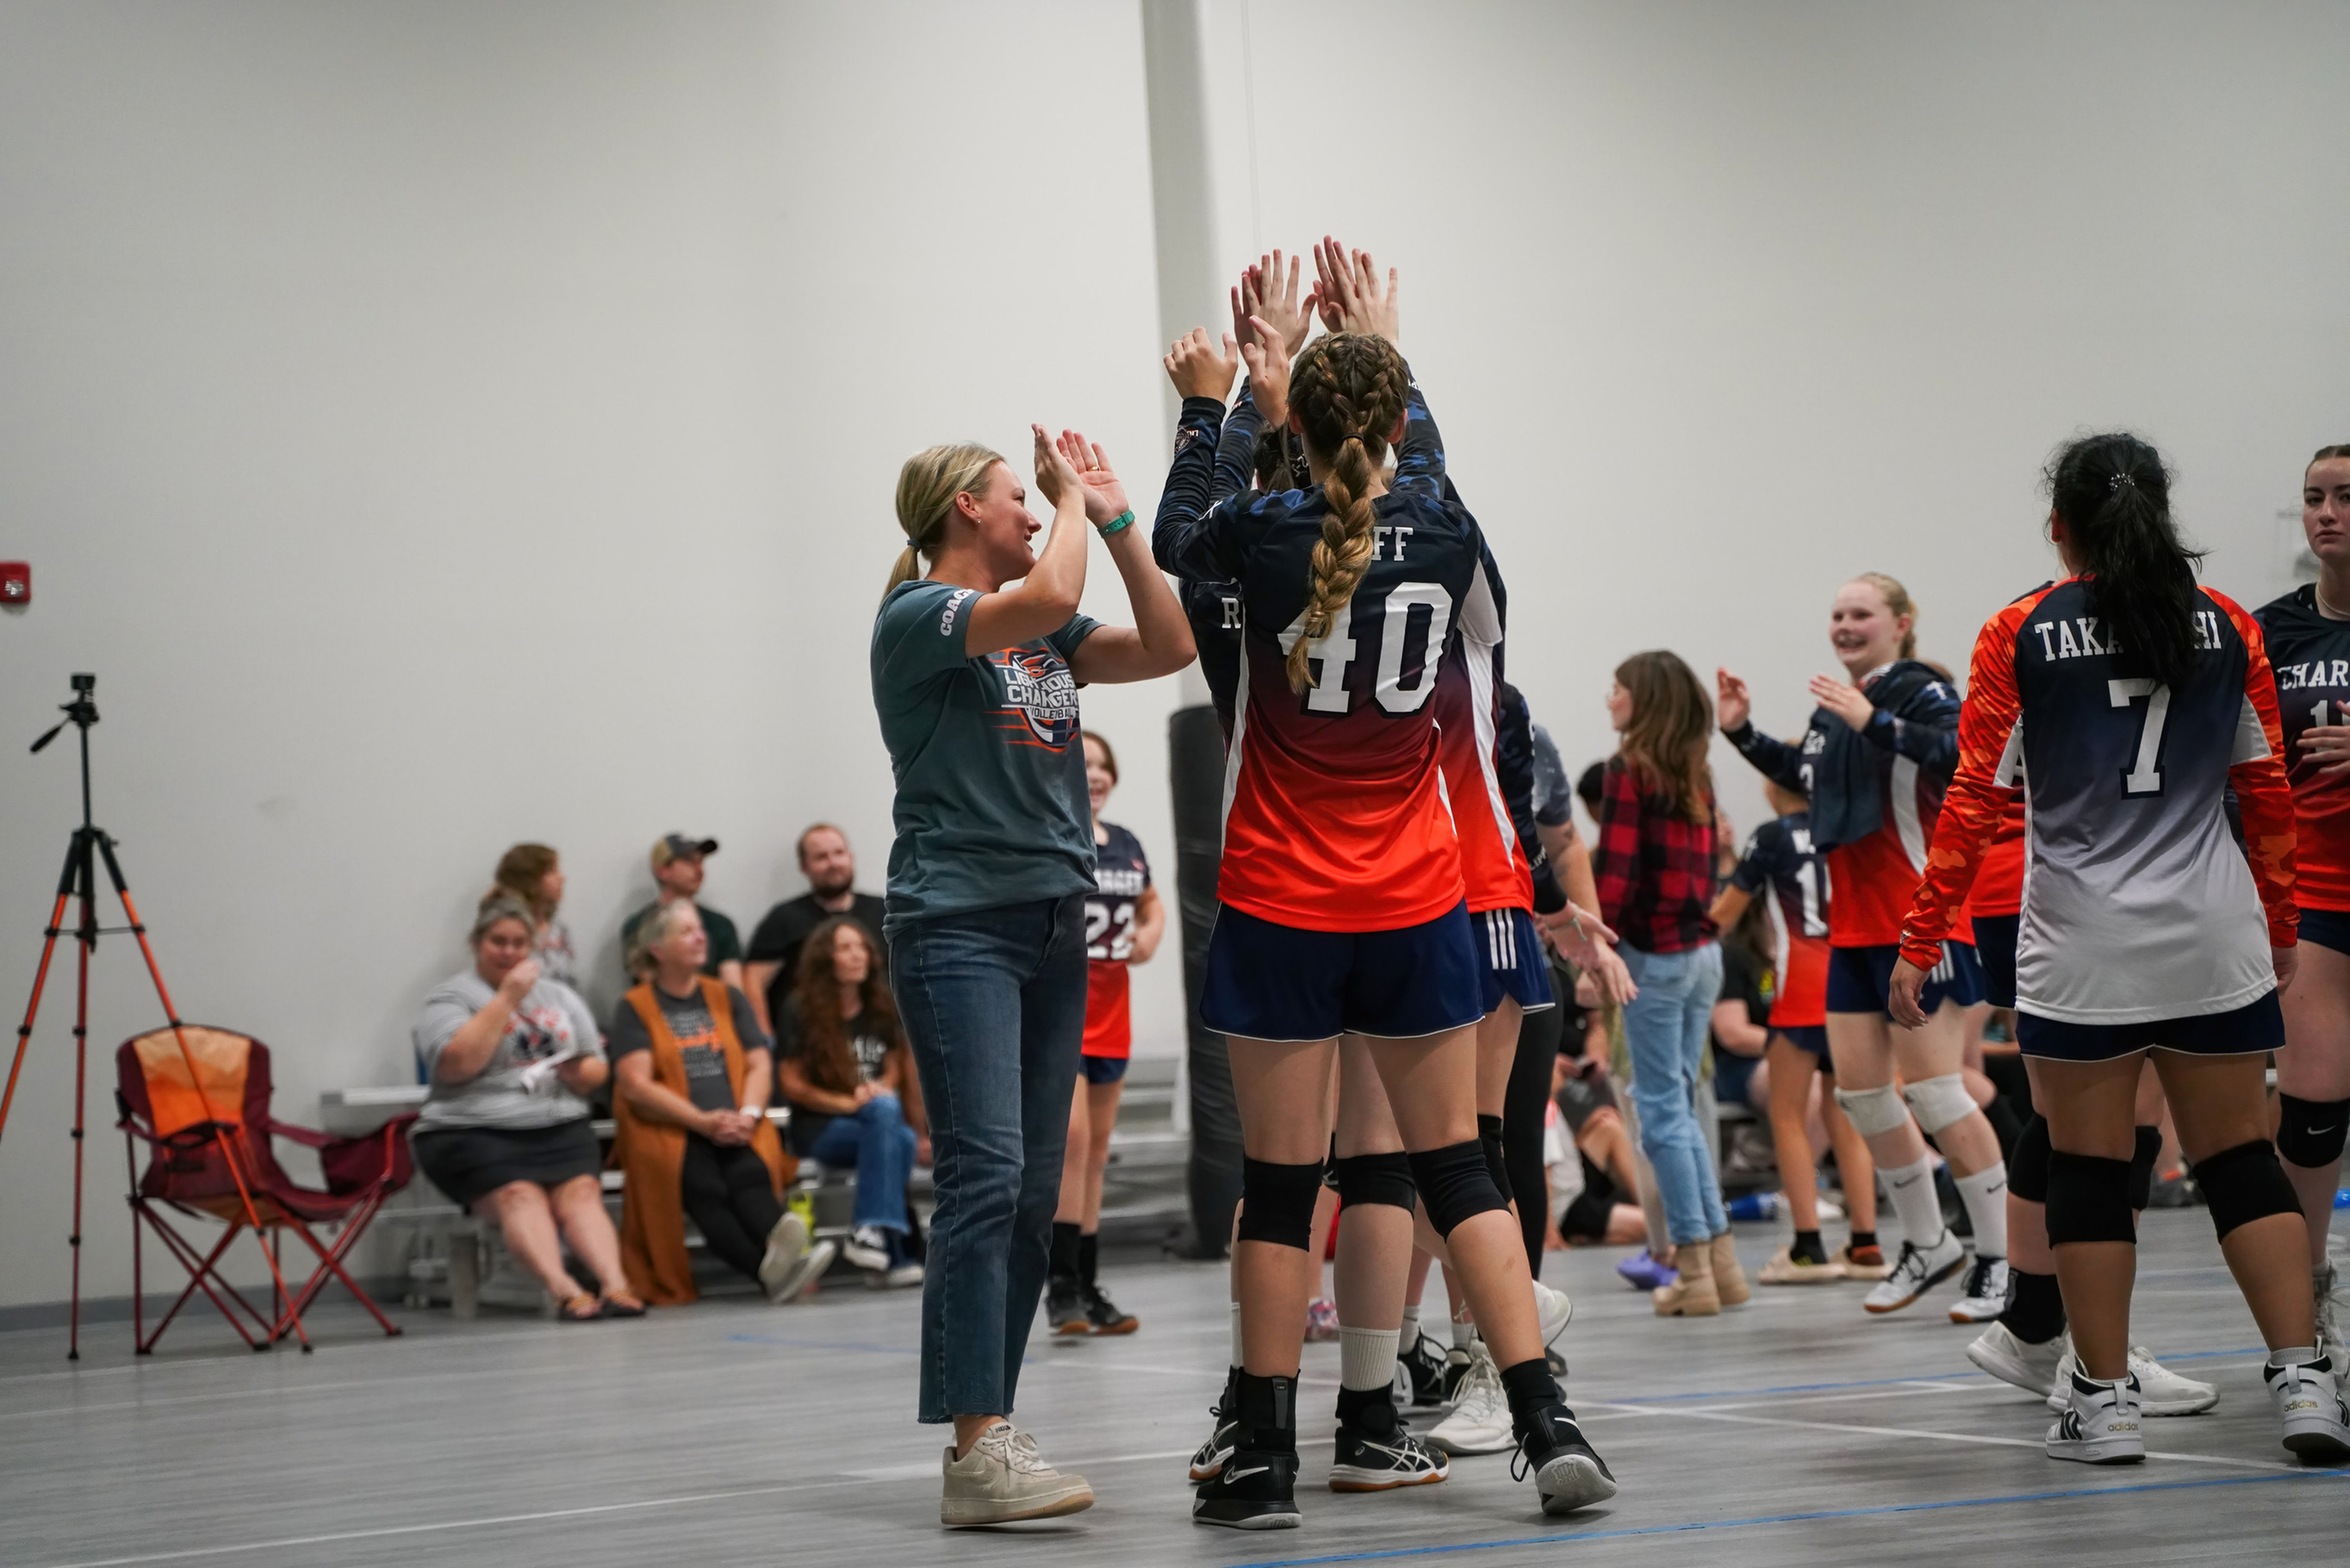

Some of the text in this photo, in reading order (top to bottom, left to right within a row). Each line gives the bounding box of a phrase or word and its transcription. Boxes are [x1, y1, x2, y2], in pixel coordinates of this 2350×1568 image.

[1370, 526, 1414, 561] FF
[940, 588, 975, 636] COAC
[2034, 611, 2222, 662] TAKAHI
[1277, 581, 1453, 713] 40
[1007, 685, 1079, 708] CHARGER
[2108, 677, 2171, 793] 7
[1084, 902, 1135, 960] 22
